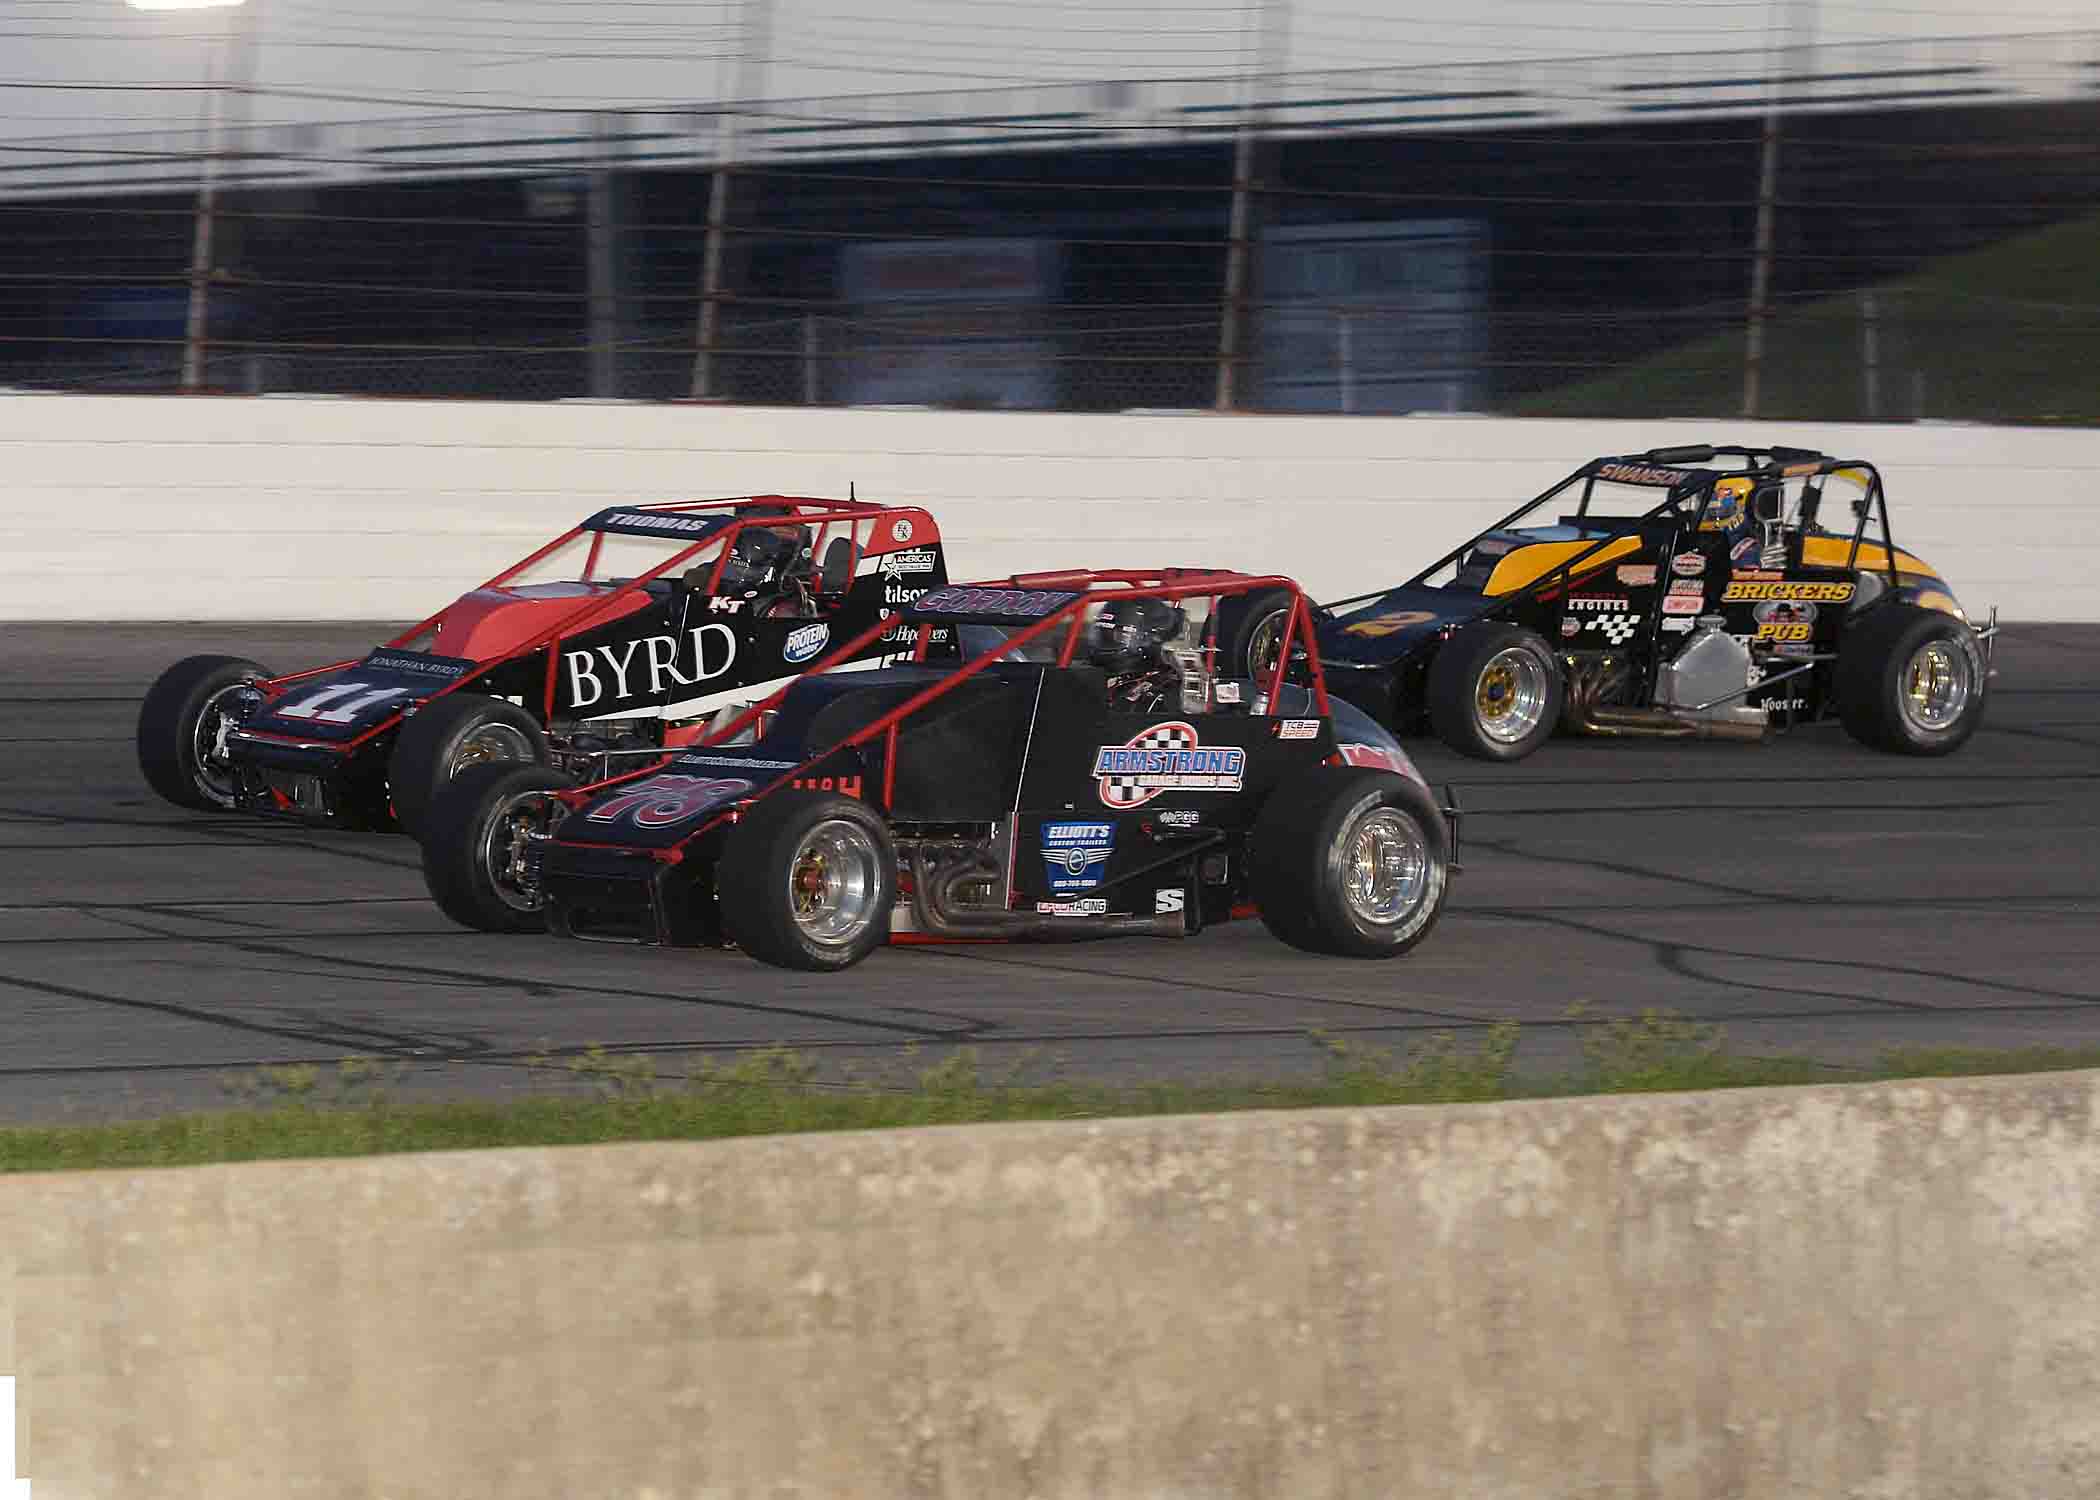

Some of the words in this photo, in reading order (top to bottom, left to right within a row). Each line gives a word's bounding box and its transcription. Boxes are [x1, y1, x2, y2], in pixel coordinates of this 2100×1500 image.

[606, 513, 708, 531] THOMAS
[895, 554, 932, 563] AMERICAS
[1725, 583, 1854, 600] BRICKERS
[708, 596, 745, 614] KT
[787, 623, 828, 653] PROTEIN
[1756, 623, 1810, 641] PUB
[562, 622, 737, 708] BYRD
[272, 682, 409, 725] 11
[1099, 750, 1242, 774] ARMSTRONG
[1048, 824, 1111, 839] ELLIOTT'S
